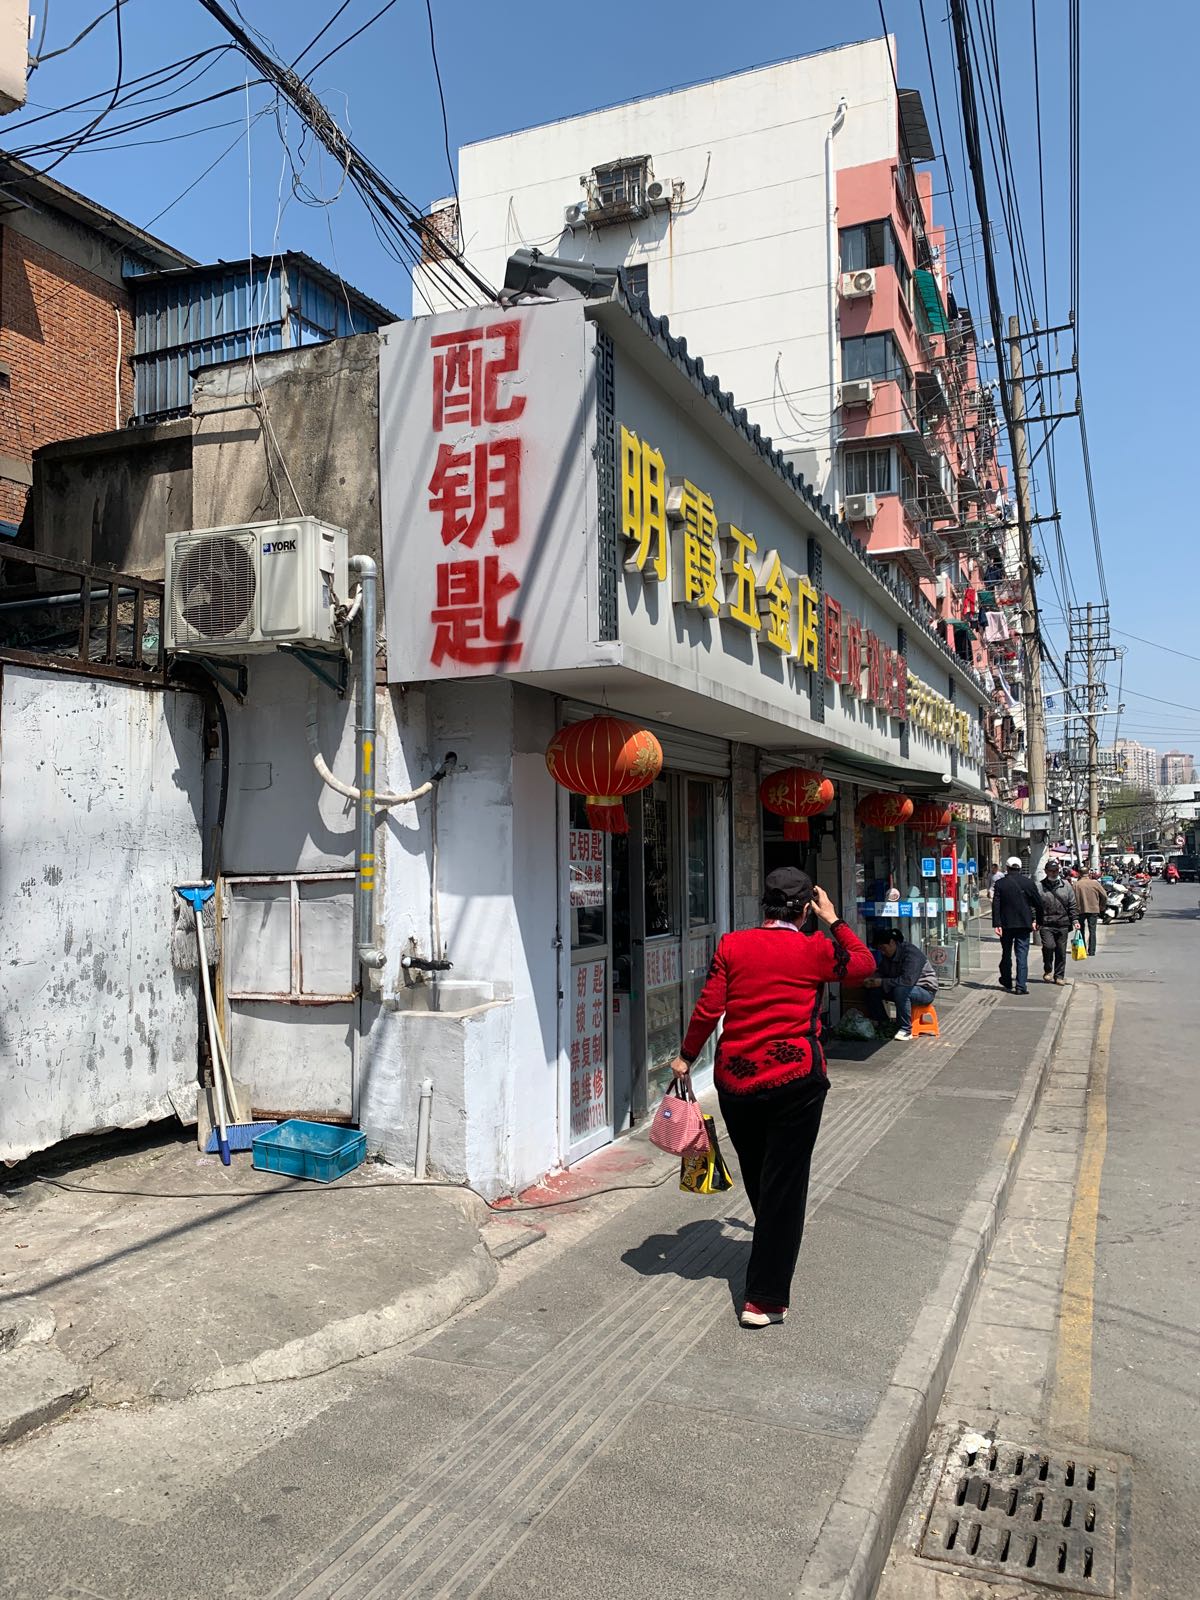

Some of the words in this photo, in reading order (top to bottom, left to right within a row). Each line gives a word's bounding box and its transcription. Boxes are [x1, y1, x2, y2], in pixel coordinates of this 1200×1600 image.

[271, 540, 296, 551] YORK
[428, 319, 527, 667] 配钥匙
[620, 424, 819, 673] 明霞五金店
